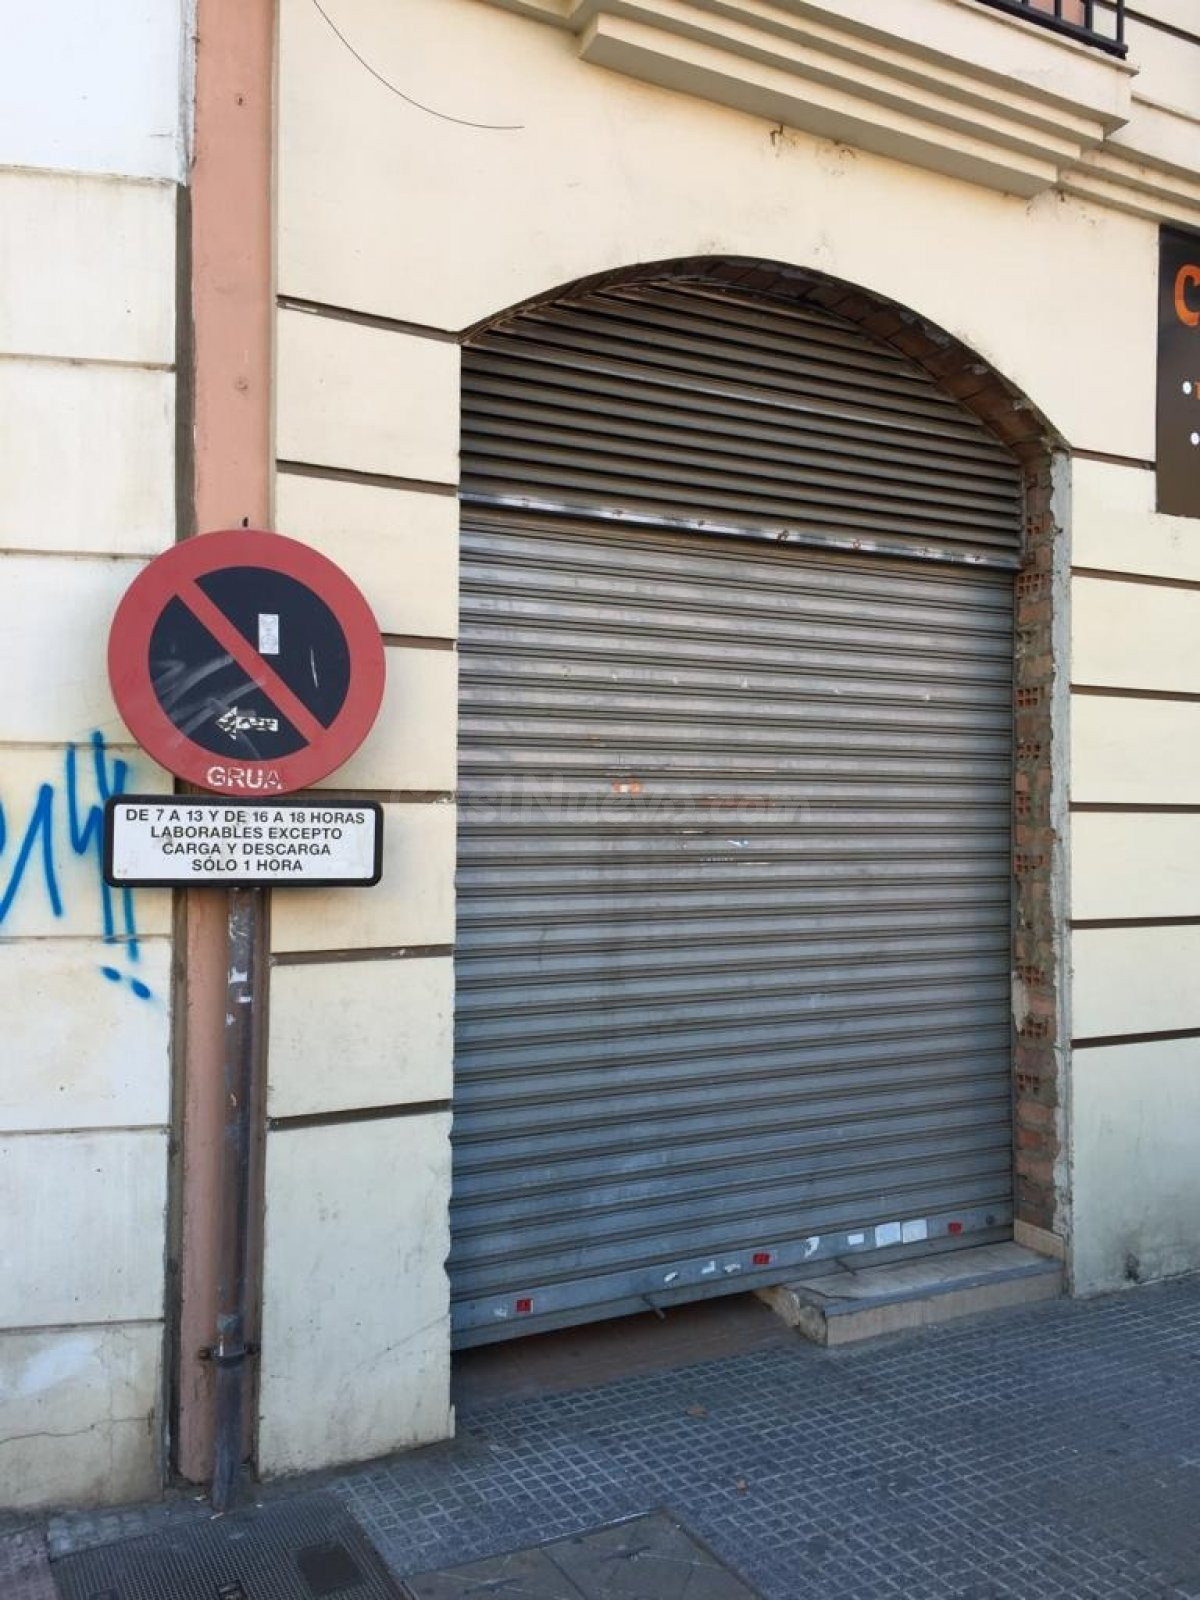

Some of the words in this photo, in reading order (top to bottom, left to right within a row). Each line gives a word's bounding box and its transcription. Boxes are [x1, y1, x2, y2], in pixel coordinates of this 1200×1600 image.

[126, 808, 149, 821] DE
[155, 808, 164, 821] 7
[169, 808, 181, 822] A
[187, 809, 203, 822] 13
[208, 810, 219, 823] Y
[224, 810, 246, 823] DE
[253, 810, 268, 823] 16
[273, 811, 284, 823] A
[290, 811, 305, 823] 18
[310, 811, 365, 824] HORAS
[151, 825, 263, 839] LABORABLES
[268, 826, 342, 840] EXCEPTO
[162, 842, 221, 855] CARGA
[227, 843, 238, 855] Y
[243, 843, 331, 856] DESCARGA
[191, 855, 237, 872] SÓLO
[243, 859, 250, 872] 1
[257, 858, 303, 872] HORA
